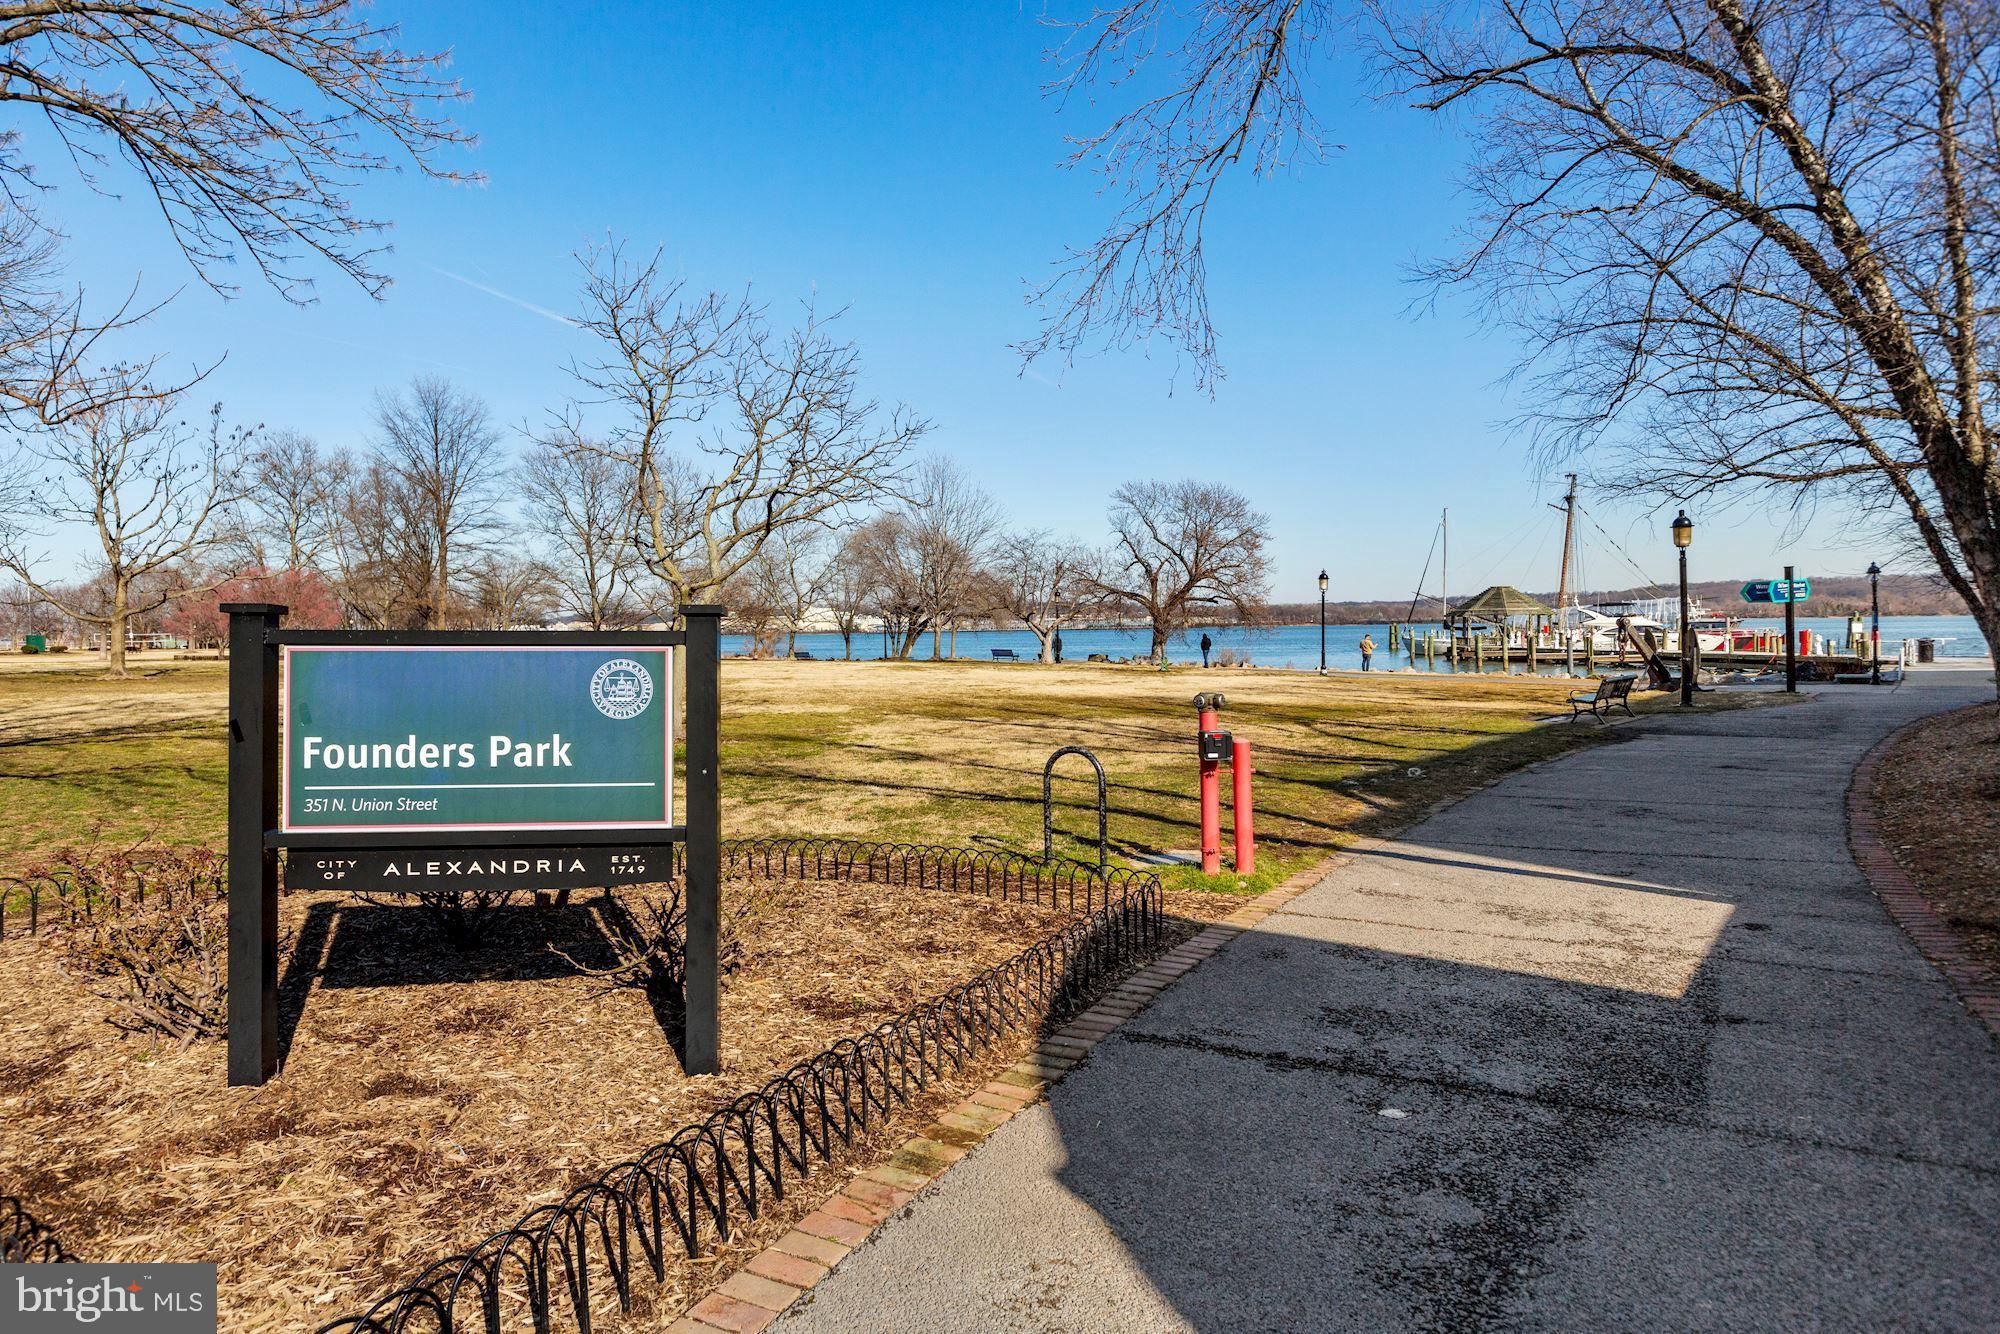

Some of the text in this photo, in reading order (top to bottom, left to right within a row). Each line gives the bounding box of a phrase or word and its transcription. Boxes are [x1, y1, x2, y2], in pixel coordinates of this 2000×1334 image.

[610, 661, 651, 697] ALEXANDRIA
[598, 702, 645, 717] VIRGINIA
[303, 733, 573, 770] Founders Park
[303, 797, 439, 813] 351 N. Union Street
[316, 860, 357, 869] CITY
[611, 855, 646, 863] EST.
[383, 858, 586, 877] ALEXANDRIA
[610, 865, 646, 875] 1749
[323, 871, 346, 880] OF
